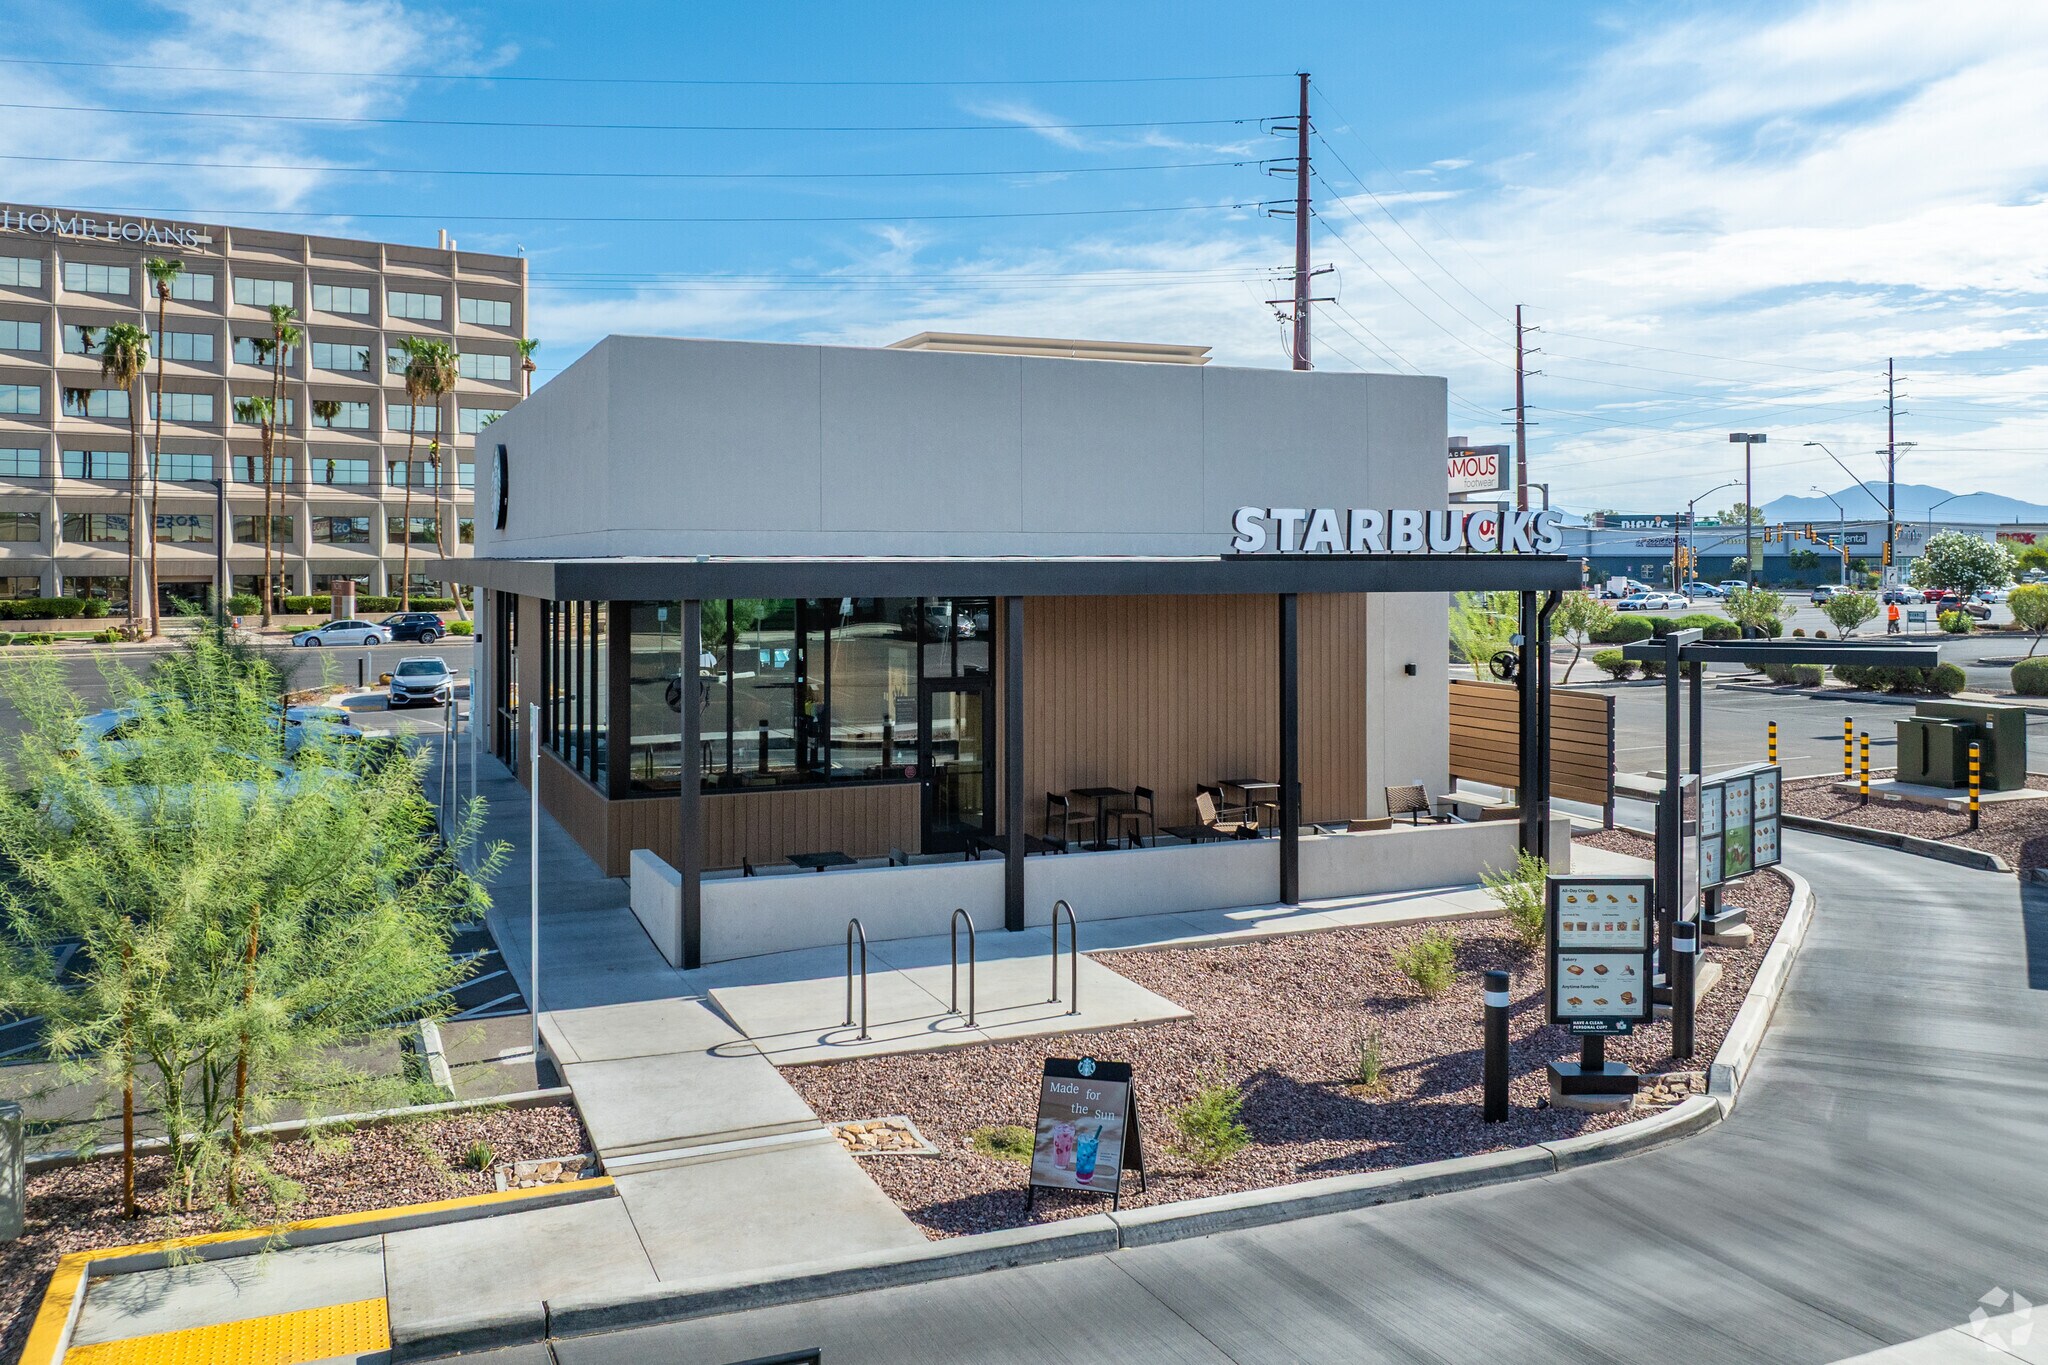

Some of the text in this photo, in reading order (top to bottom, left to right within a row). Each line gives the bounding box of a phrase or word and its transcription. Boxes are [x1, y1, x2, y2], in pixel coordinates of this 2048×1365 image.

[2, 210, 198, 247] HOME LOANS
[1464, 478, 1496, 488] footwear
[1233, 507, 1563, 552] STARBUCKS
[1841, 534, 1866, 543] ental
[1050, 1081, 1101, 1100] Made for
[1071, 1103, 1115, 1121] the Sun
